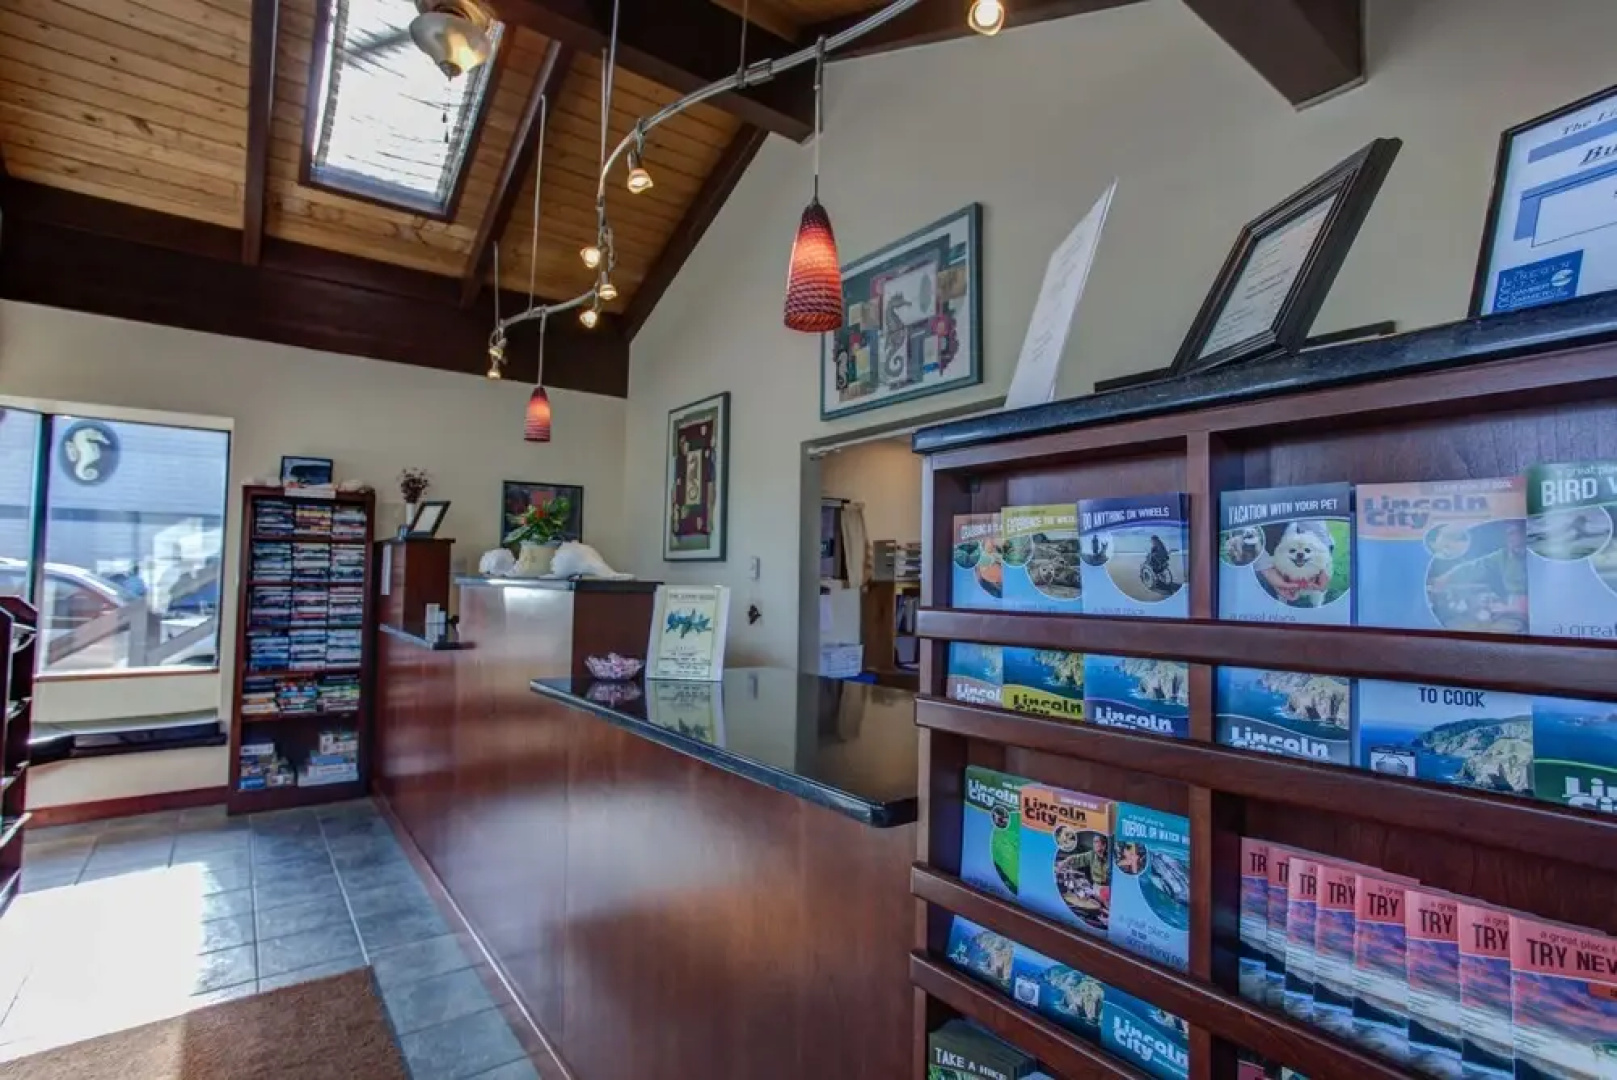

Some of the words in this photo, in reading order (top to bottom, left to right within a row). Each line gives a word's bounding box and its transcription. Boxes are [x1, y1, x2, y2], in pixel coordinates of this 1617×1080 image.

[1541, 477, 1598, 507] BIRD
[1138, 506, 1170, 518] WHEELS
[1228, 503, 1269, 526] VACATION
[1270, 501, 1293, 517] WITH
[1294, 499, 1319, 512] YOUR
[1320, 498, 1338, 511] PET
[1364, 494, 1490, 516] Lincoln
[1365, 508, 1430, 530] City
[956, 683, 1001, 701] Lincol
[1417, 686, 1438, 704] TO
[1443, 688, 1486, 708] COOK
[1013, 694, 1083, 716] Lincoln
[1095, 706, 1174, 733] Lincoln
[1231, 725, 1328, 760] Lincoln
[968, 778, 1019, 804] Lincoln
[1024, 796, 1086, 821] Lincoln
[1025, 807, 1058, 827] City
[1249, 852, 1267, 873] TR
[1299, 873, 1317, 895] TR
[1367, 892, 1400, 917] TRY
[1418, 908, 1453, 934] TRY
[1472, 923, 1509, 950] TRY
[1526, 937, 1568, 969] TRY
[1113, 1015, 1189, 1069] Lincoln
[1113, 1028, 1155, 1062] City
[935, 1046, 965, 1069] TAKE
[968, 1061, 976, 1073] A
